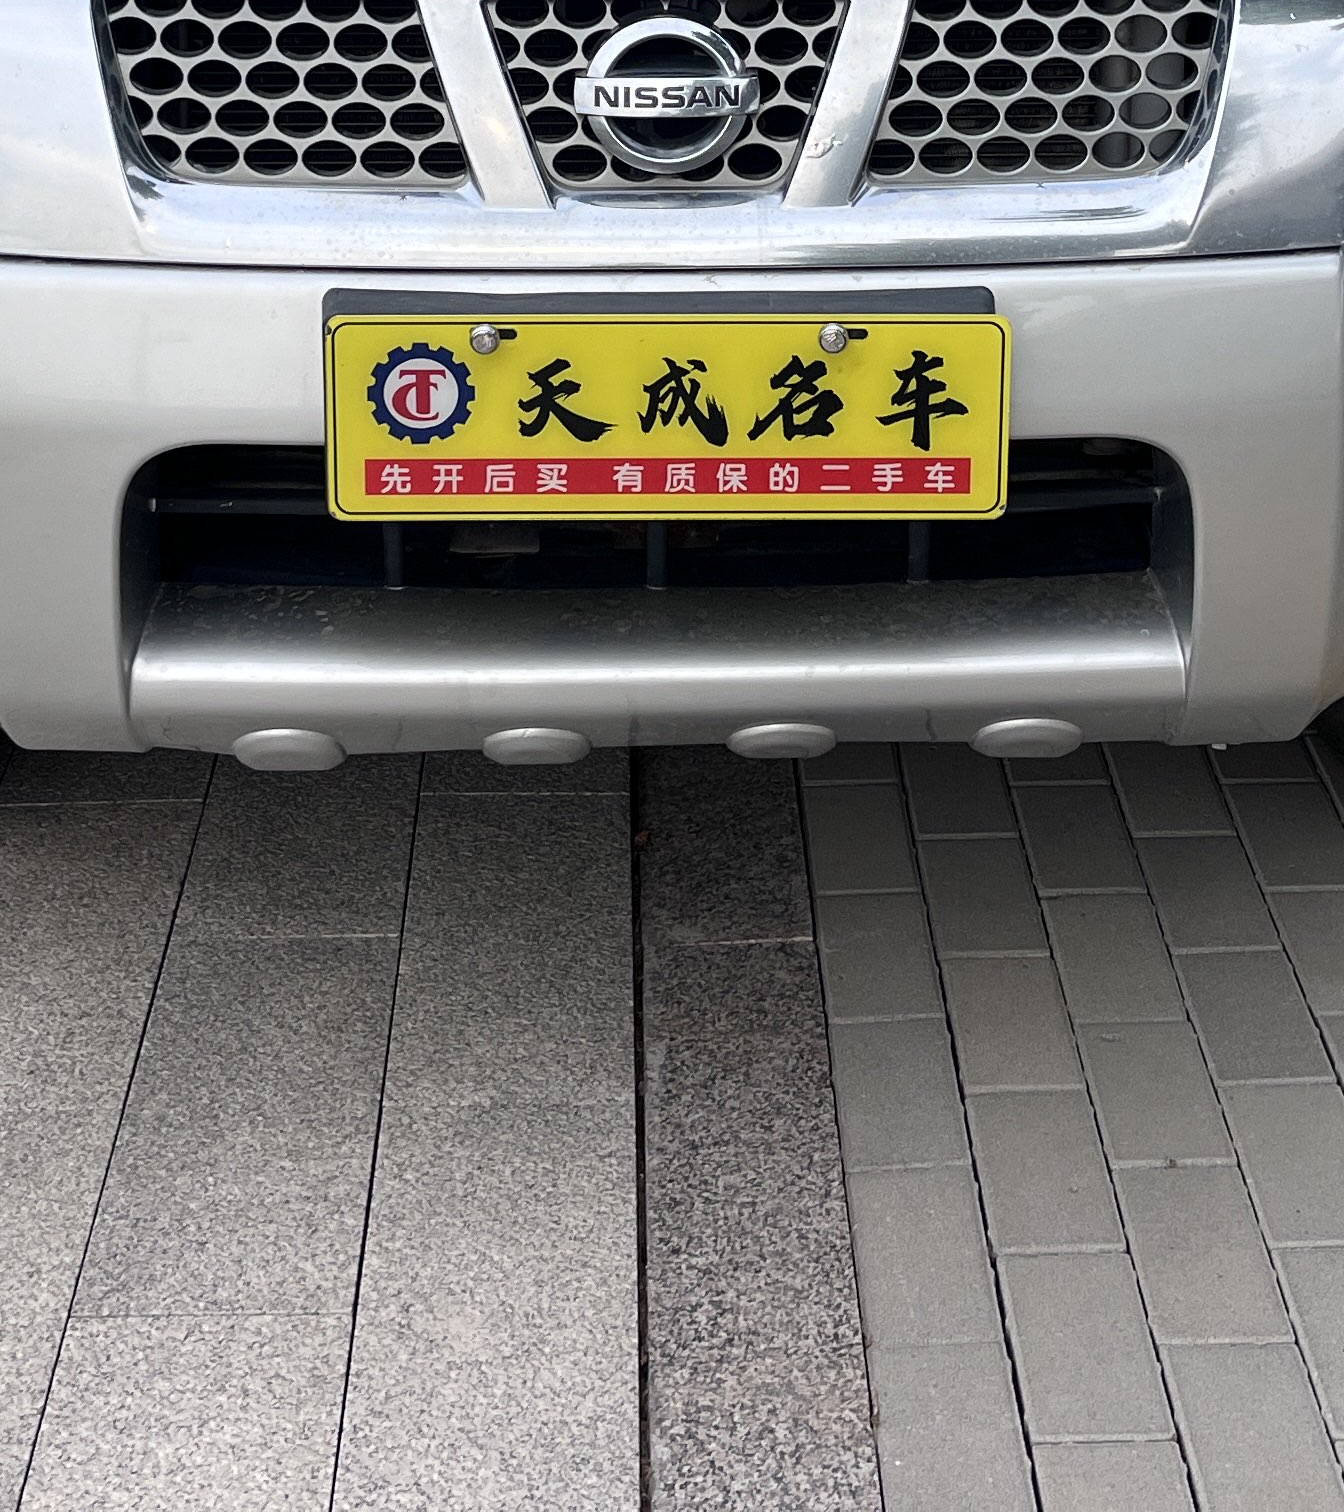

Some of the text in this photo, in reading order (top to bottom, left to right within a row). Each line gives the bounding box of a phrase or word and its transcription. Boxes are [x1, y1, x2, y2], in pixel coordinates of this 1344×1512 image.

[594, 85, 741, 108] NISSAN
[518, 350, 969, 452] 天成名车
[380, 462, 956, 494] 先开后买 有质保的二手车
